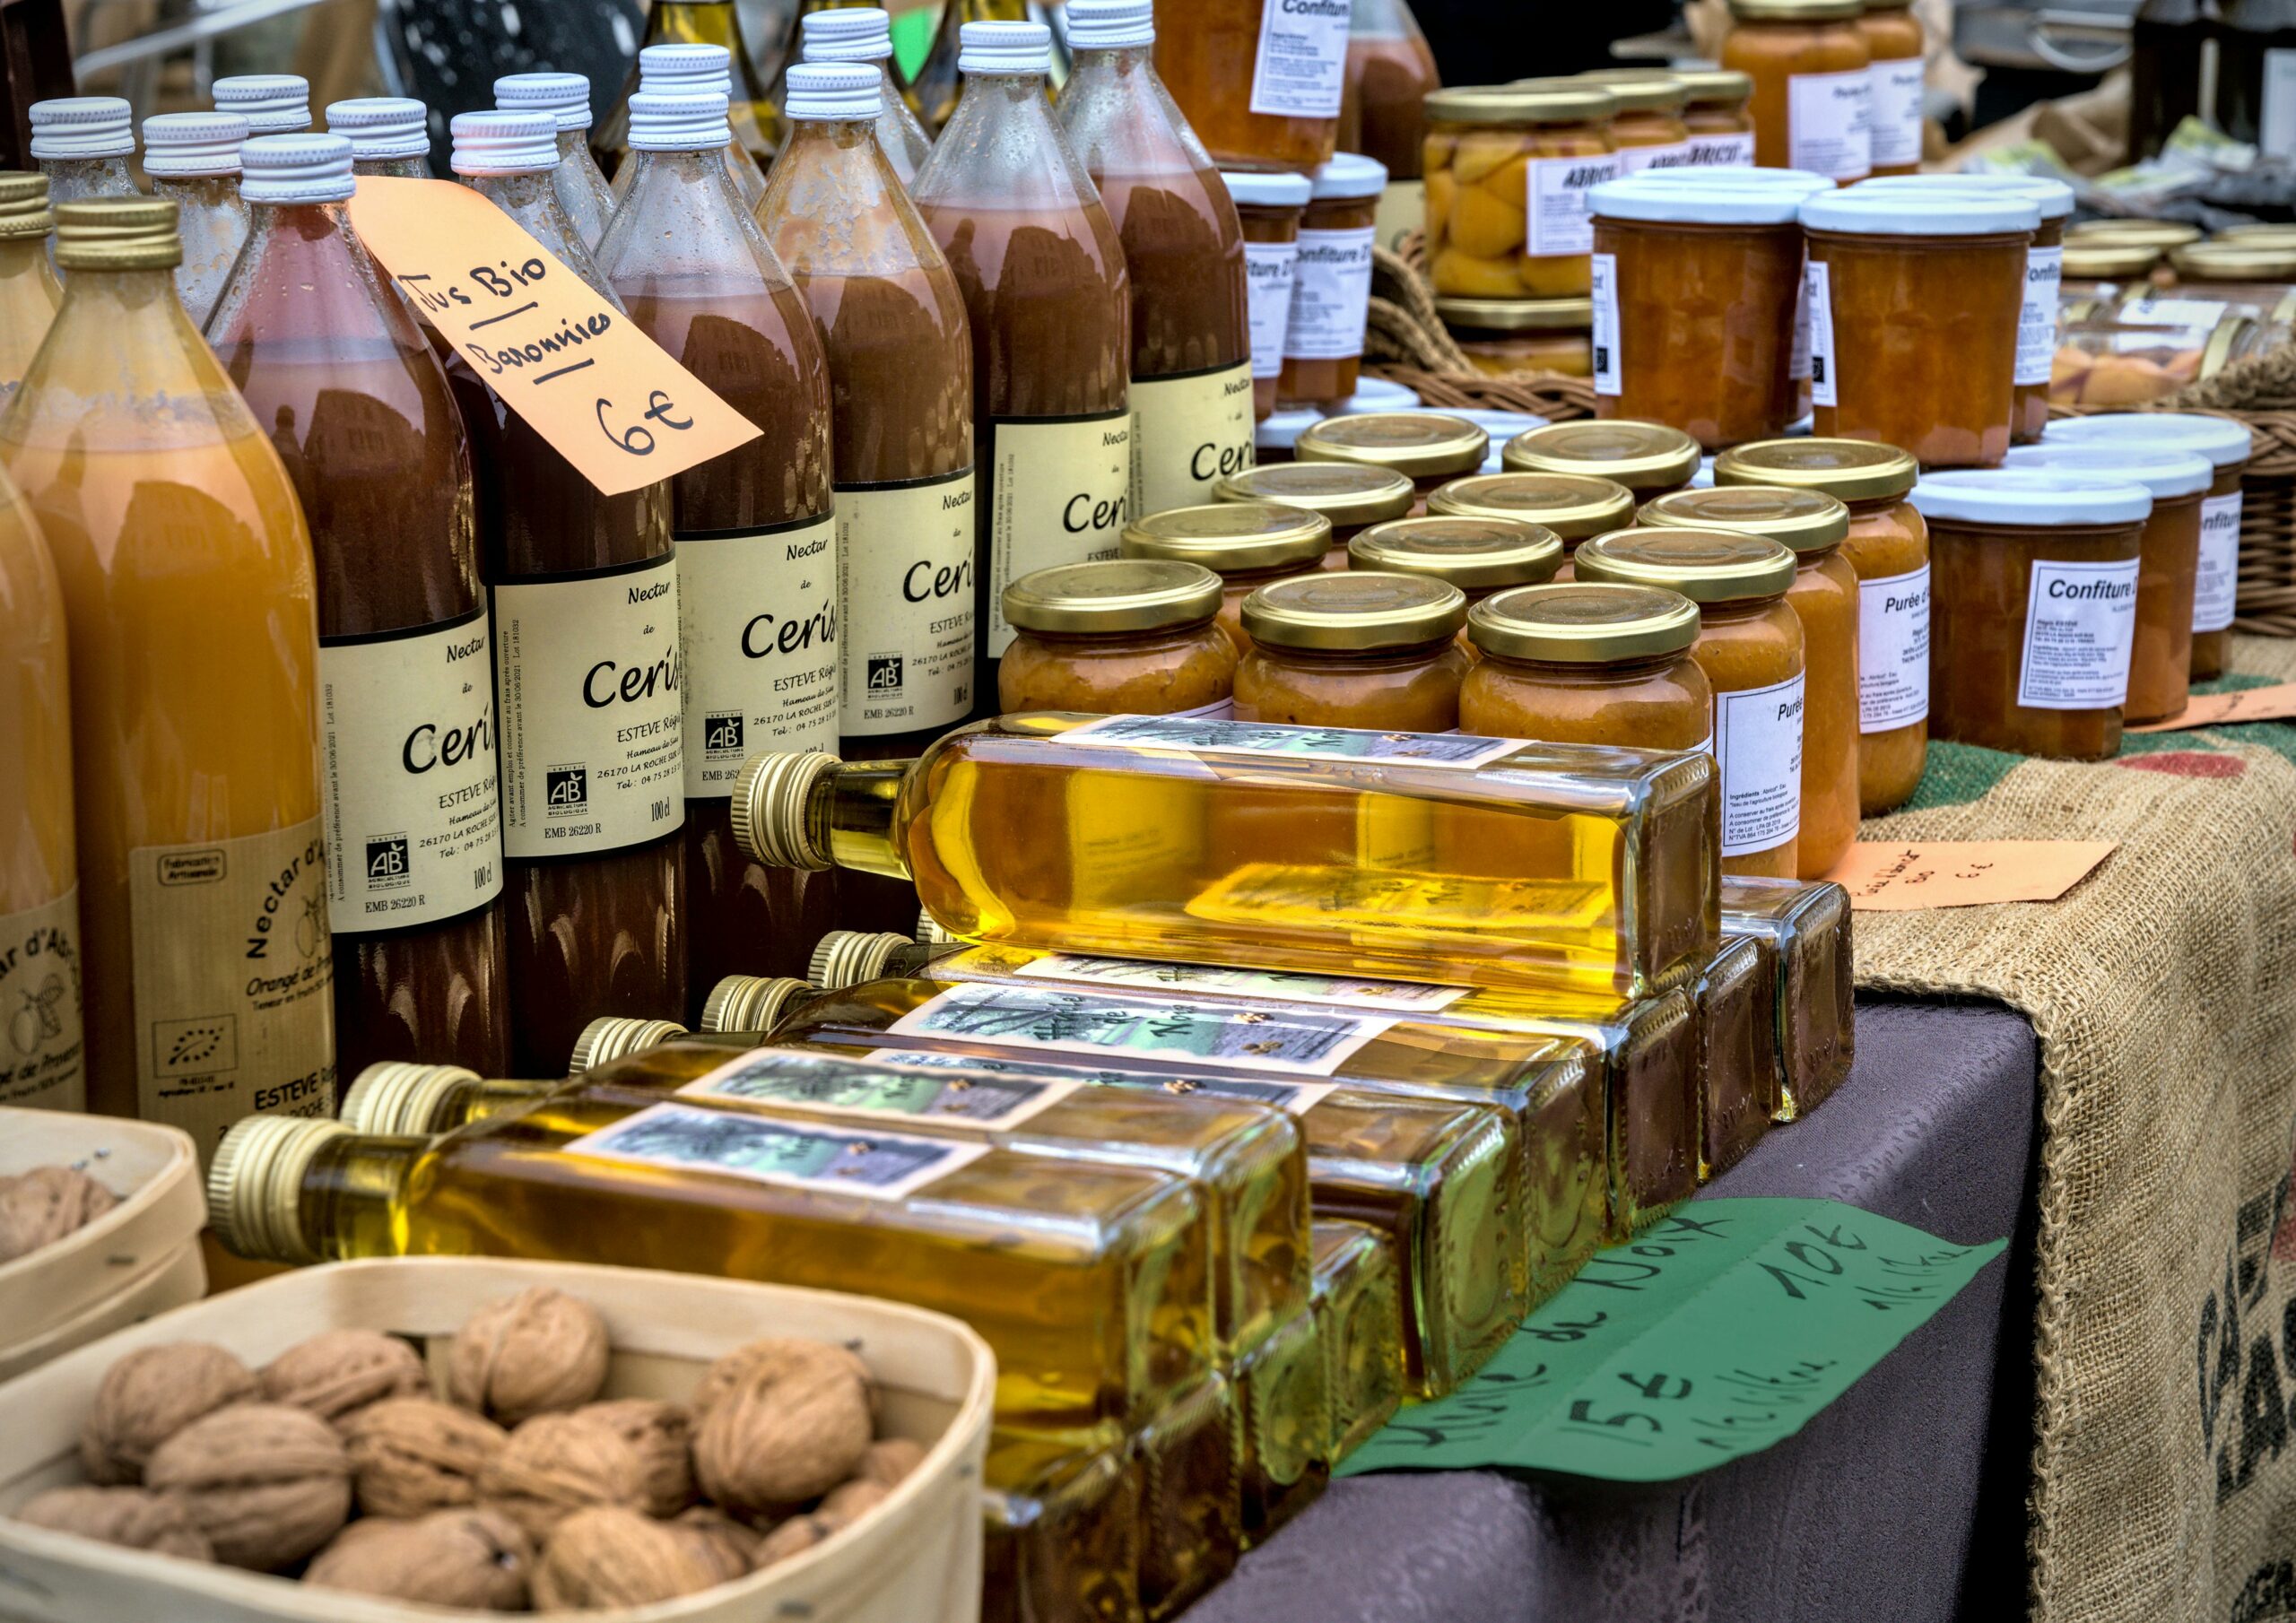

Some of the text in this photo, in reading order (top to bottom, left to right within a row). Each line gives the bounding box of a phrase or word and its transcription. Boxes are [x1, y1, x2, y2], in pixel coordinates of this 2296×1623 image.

[1690, 143, 1742, 165] BRICOT
[469, 257, 546, 298] Bio
[596, 390, 694, 456] 6€
[787, 539, 828, 560] Nectar
[800, 580, 812, 590] de
[903, 547, 974, 603] Ceri
[628, 582, 671, 604] Nectar
[2048, 578, 2131, 600] Confiture
[1884, 591, 1920, 613] Purée
[643, 625, 655, 635] de
[742, 598, 836, 659] Ceris
[447, 636, 485, 663] Nectar
[501, 630, 509, 665] ouverture
[512, 647, 520, 658] Lot
[503, 666, 511, 686] après
[583, 644, 679, 708] Ceris
[774, 671, 816, 691] ESTEVE
[870, 666, 898, 688] AB
[462, 682, 473, 694] de
[505, 705, 511, 715] au
[782, 694, 817, 707] Hameau
[753, 714, 784, 725] 26170
[786, 711, 796, 720] LA
[799, 703, 822, 717] ROCHE
[864, 709, 883, 719] EMB
[617, 721, 661, 743] ESTEVE
[709, 725, 738, 748] AB
[796, 722, 805, 732] 04
[808, 719, 816, 728] 75
[516, 733, 525, 769] préférence
[627, 745, 662, 759] Hameau
[507, 759, 515, 784] emploi
[517, 772, 525, 780] de
[596, 767, 628, 778] 26170
[631, 764, 641, 773] LA
[643, 755, 666, 770] ROCHE
[641, 775, 651, 785] 04
[653, 772, 662, 781] 75
[663, 768, 671, 778] 28
[702, 768, 740, 781] EMB 262
[439, 783, 482, 809] ESTEVE
[551, 778, 581, 803] AB
[1730, 791, 1760, 801] Ingrédients
[448, 805, 483, 826] Hameau
[508, 806, 516, 828] Agiter
[651, 796, 671, 822] 100 cl
[333, 803, 343, 842] préférence
[544, 822, 602, 839] EMB 26220 R
[1735, 817, 1761, 826] consommer
[419, 820, 488, 848] 26170 LA ROCHE
[464, 842, 474, 852] 04
[475, 838, 483, 848] 75
[335, 844, 343, 852] de
[370, 850, 403, 876] AB
[336, 855, 345, 895] consommer
[474, 866, 486, 890] 100
[246, 857, 300, 959] Nectar
[365, 895, 425, 913] EMB 26220 R
[1033, 996, 1084, 1040] Huile
[255, 1072, 317, 1111] ESTEVE
[1571, 1217, 1735, 1291] Noix
